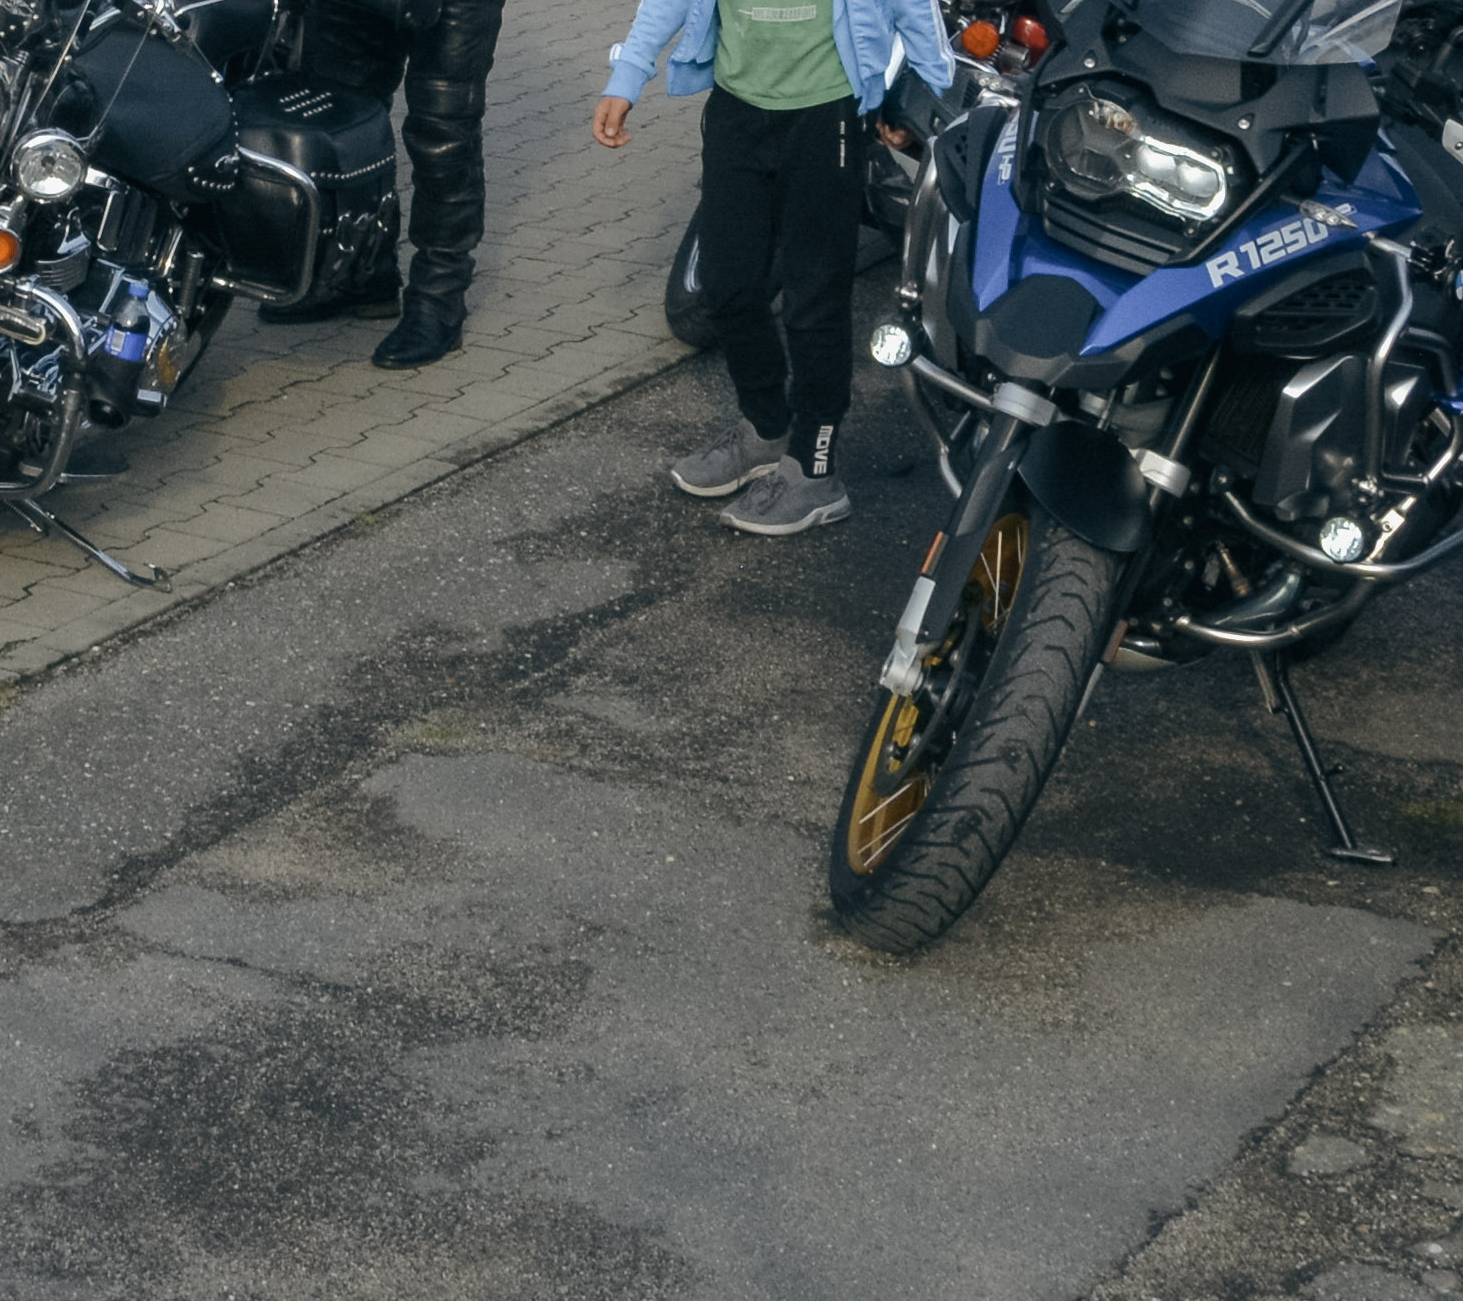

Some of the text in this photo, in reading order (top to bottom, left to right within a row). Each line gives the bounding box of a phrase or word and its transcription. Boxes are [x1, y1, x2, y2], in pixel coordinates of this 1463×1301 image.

[1205, 217, 1329, 288] R 1250
[813, 425, 834, 475] MOVE
